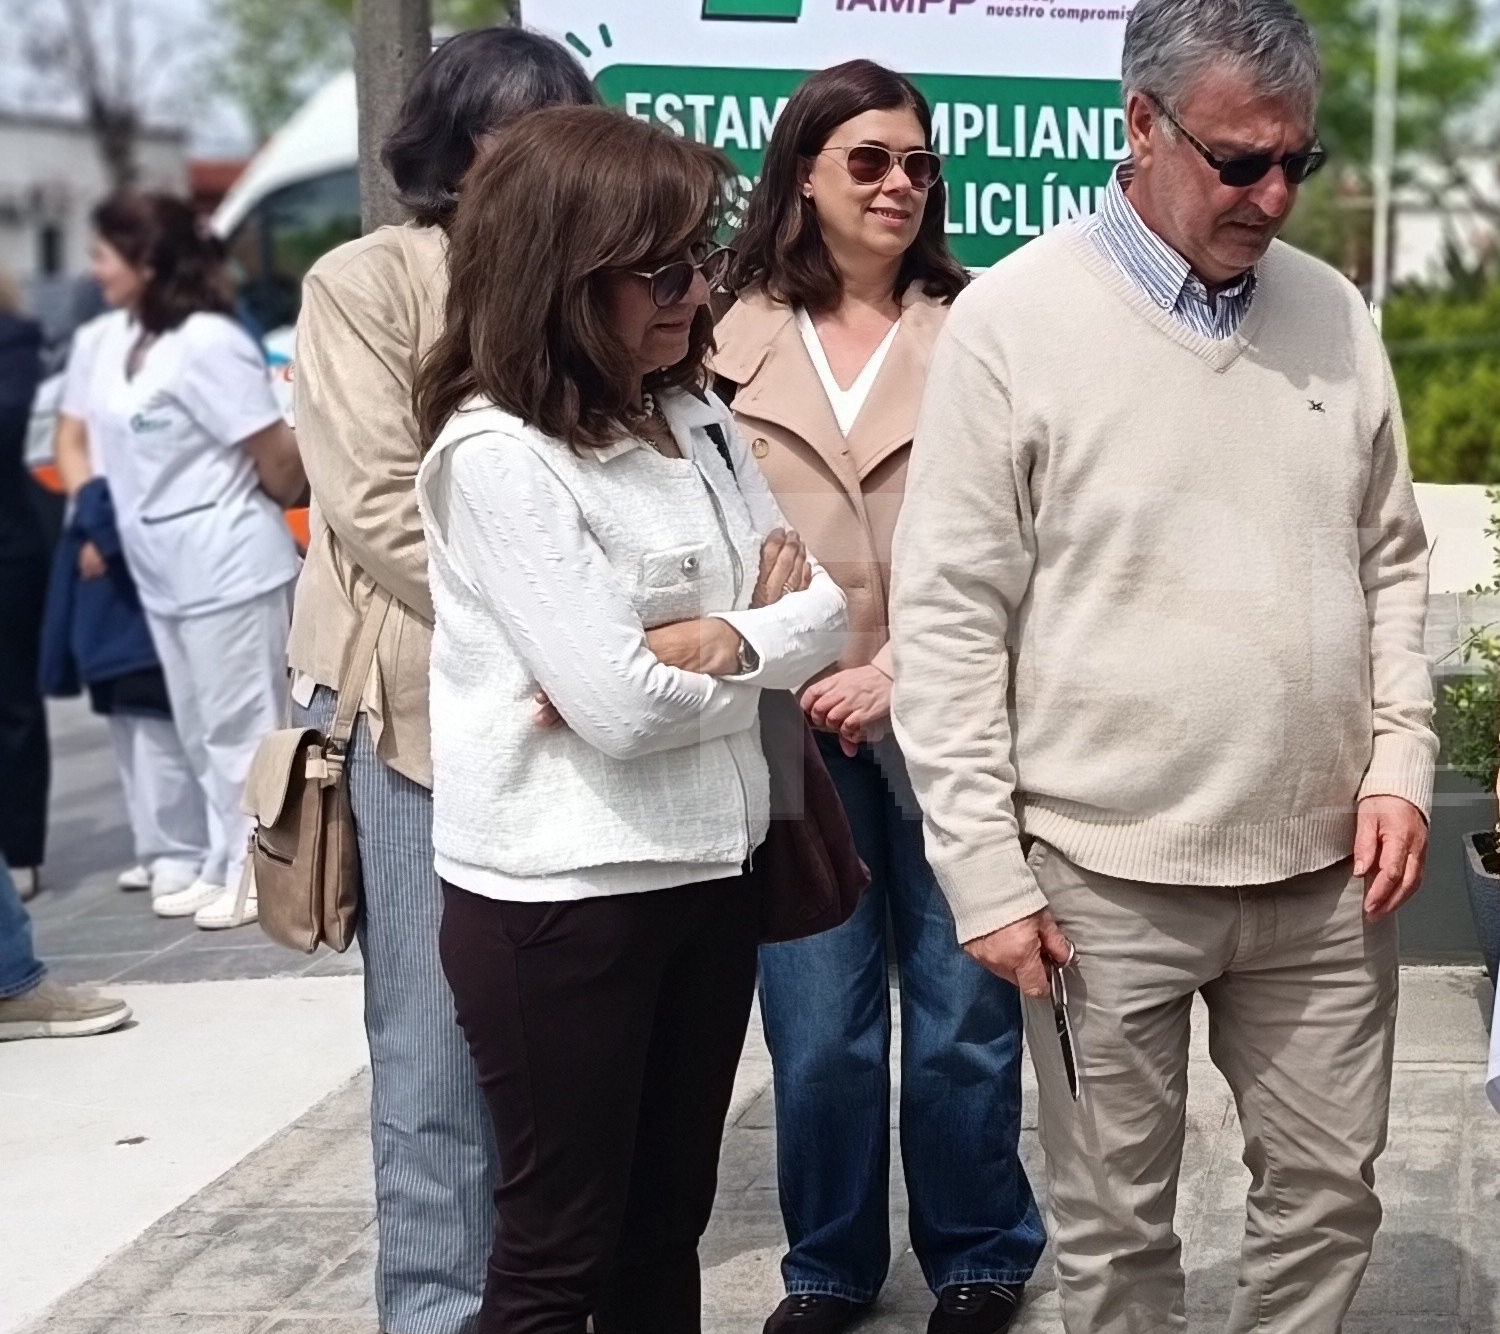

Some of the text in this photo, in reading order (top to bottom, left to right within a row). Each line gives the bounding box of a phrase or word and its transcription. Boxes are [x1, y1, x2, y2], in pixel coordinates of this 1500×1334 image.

[986, 4, 1134, 23] nuestro compromis
[625, 92, 1131, 160] ESTAM MPLIAND
